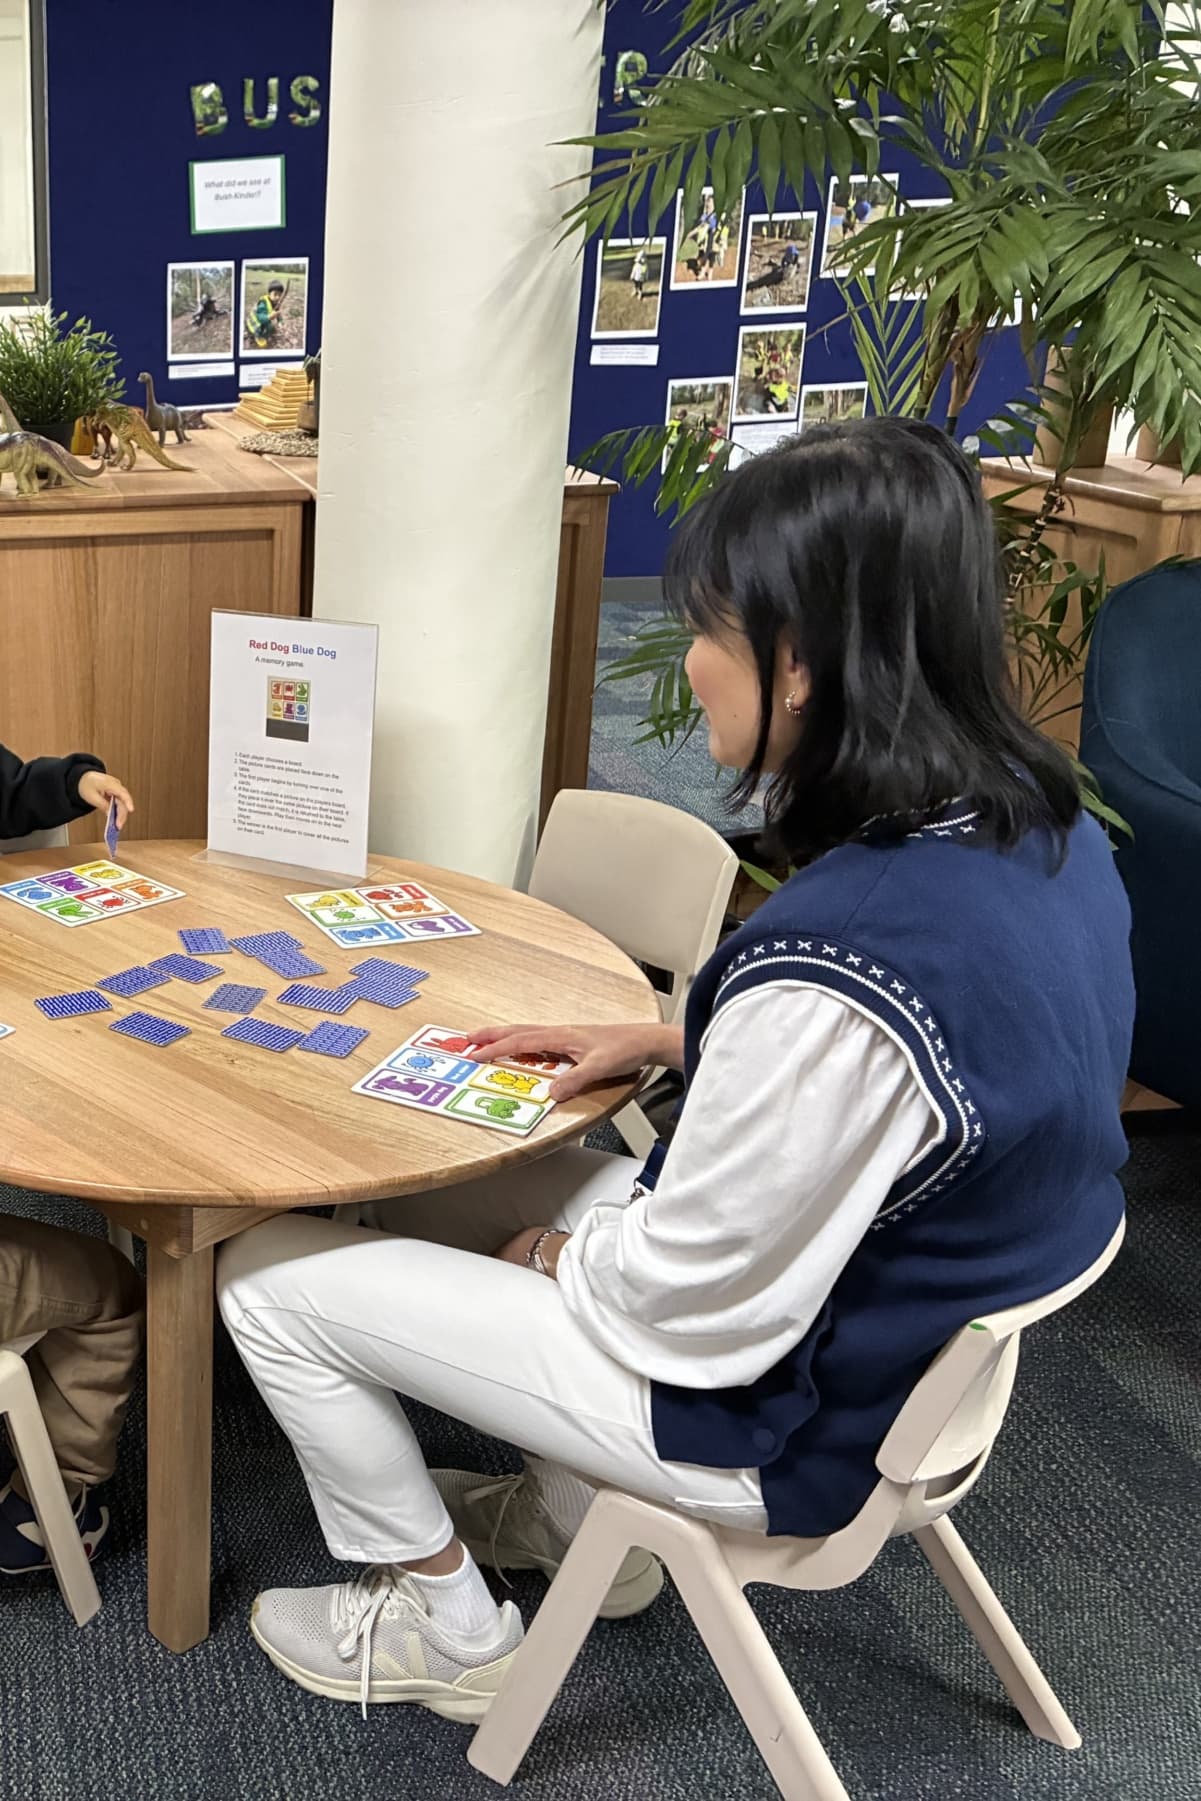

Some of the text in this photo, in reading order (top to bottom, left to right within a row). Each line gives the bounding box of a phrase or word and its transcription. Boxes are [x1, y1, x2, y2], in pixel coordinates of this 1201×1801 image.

[190, 76, 320, 135] BUS
[249, 640, 336, 659] Red Dog Blue Dog
[261, 657, 284, 666] memory
